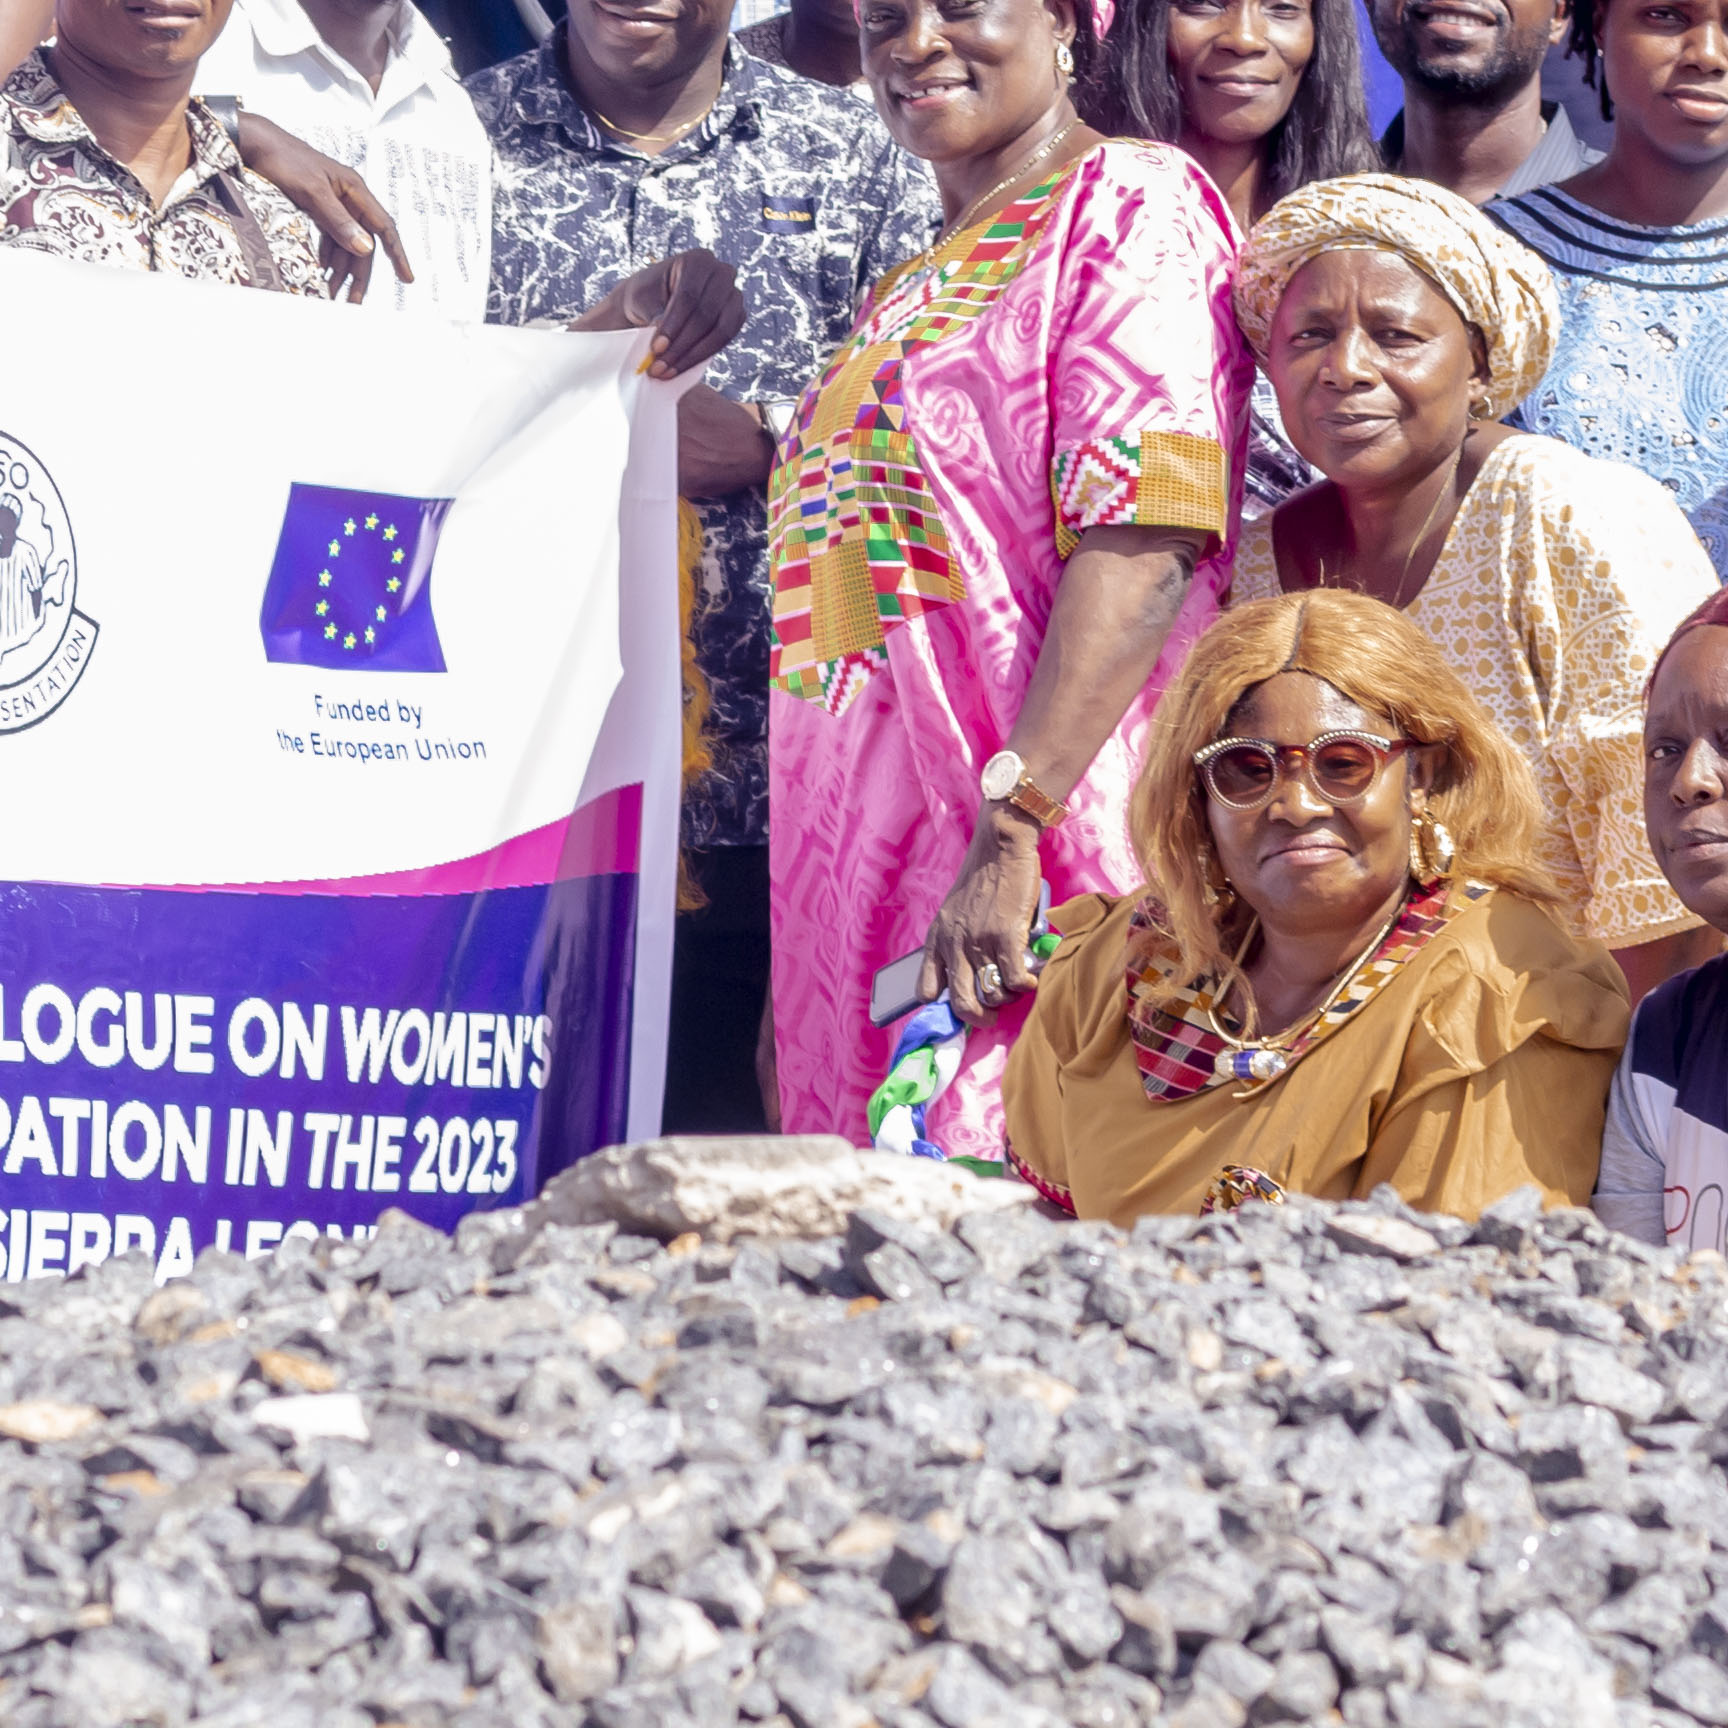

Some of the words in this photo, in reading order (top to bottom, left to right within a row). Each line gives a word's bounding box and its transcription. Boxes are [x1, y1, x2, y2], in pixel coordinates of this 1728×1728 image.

[314, 694, 391, 723] Funded
[397, 698, 422, 729] by
[276, 728, 305, 754] the
[310, 731, 409, 764] European
[416, 736, 487, 761] Union
[227, 997, 328, 1080] ON
[339, 1004, 553, 1090] WOMEN'S
[224, 1106, 294, 1188] IN
[302, 1111, 408, 1193] THE
[407, 1115, 519, 1194] 2023
